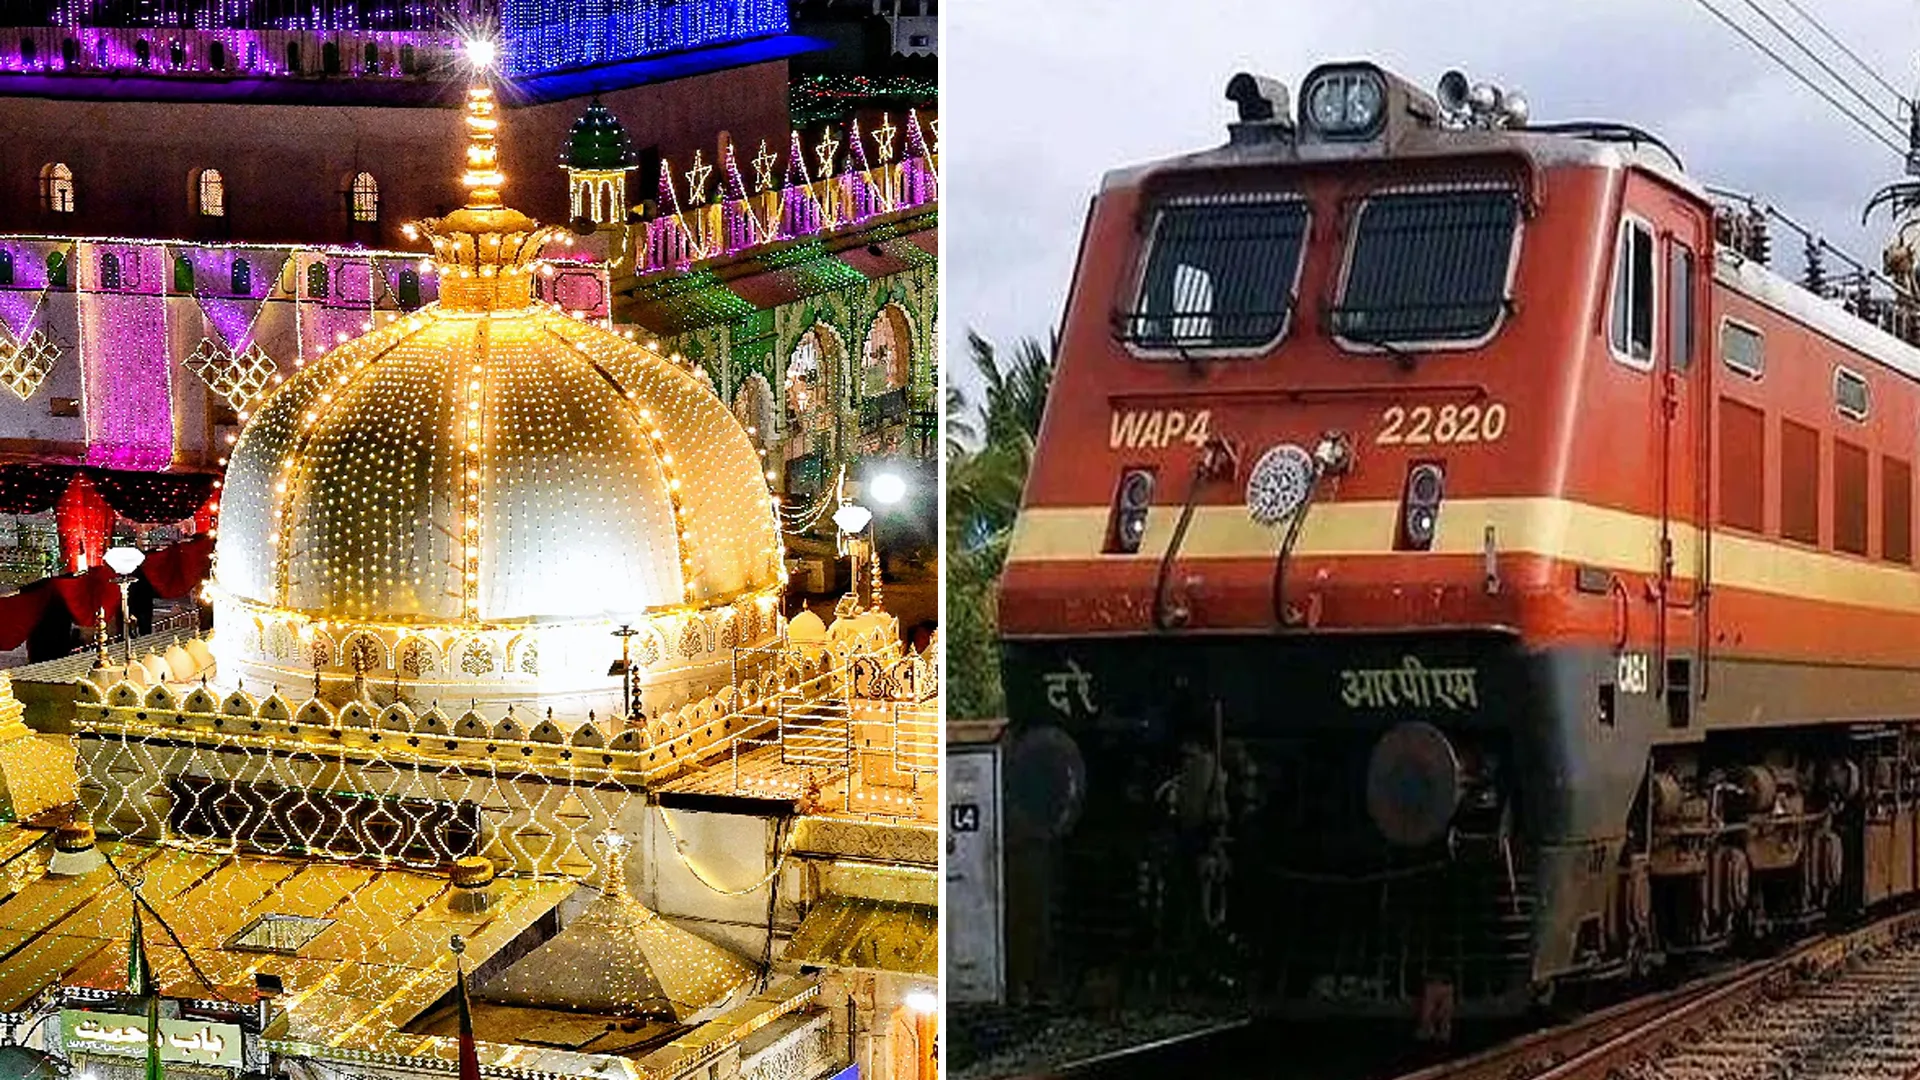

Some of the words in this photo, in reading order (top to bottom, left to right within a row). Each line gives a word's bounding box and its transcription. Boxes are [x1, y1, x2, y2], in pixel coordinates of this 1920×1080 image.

[1110, 410, 1211, 448] WAP4
[1376, 404, 1506, 444] 22820
[1340, 654, 1479, 709] आरपीएम
[169, 1027, 224, 1060] باب
